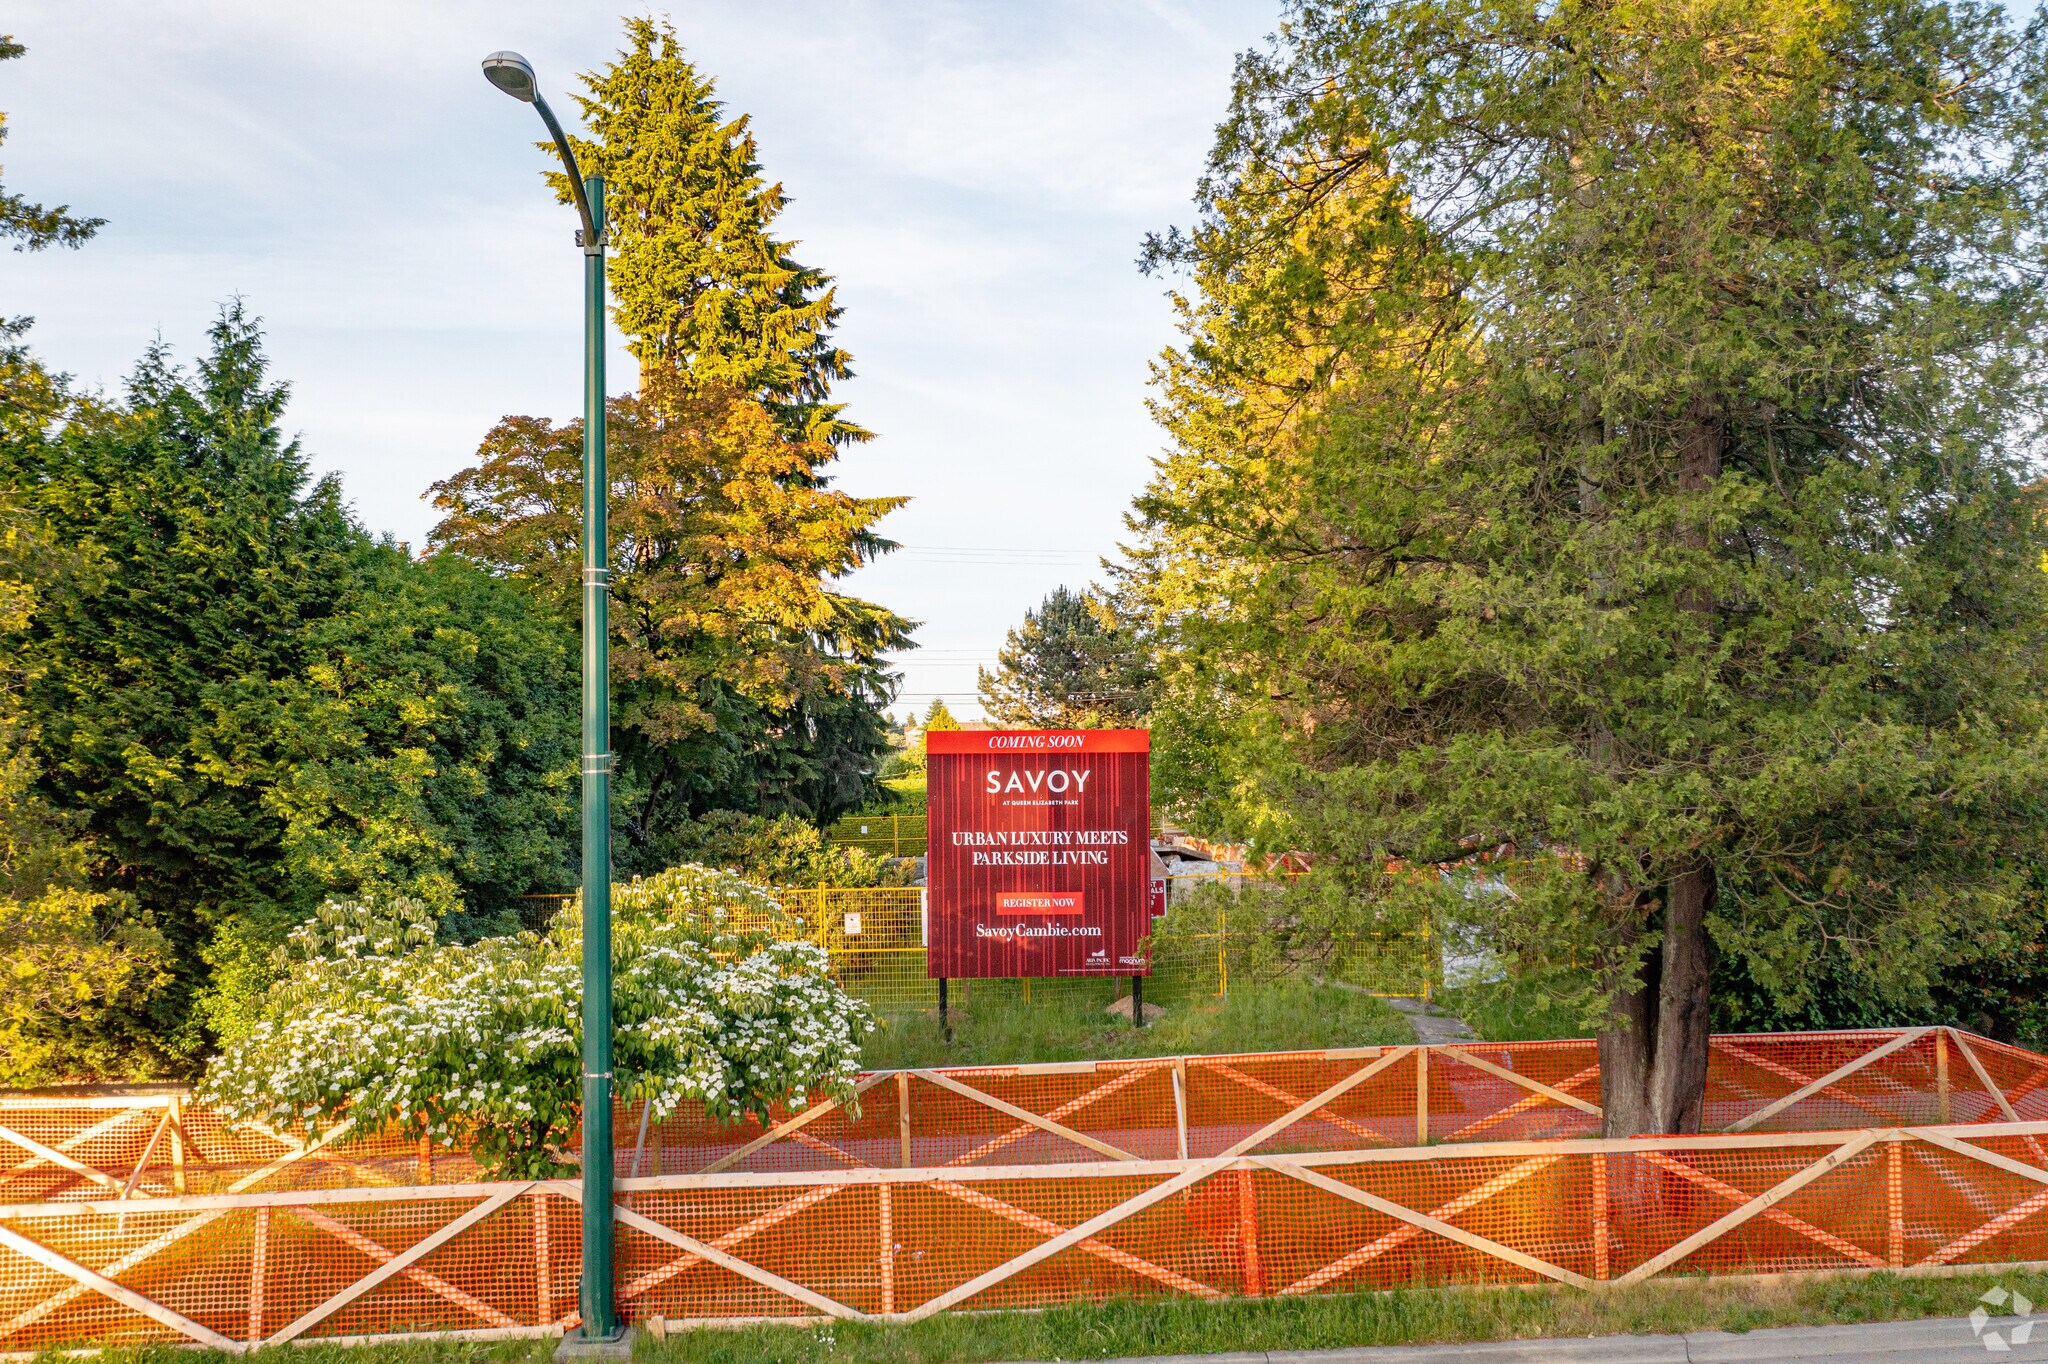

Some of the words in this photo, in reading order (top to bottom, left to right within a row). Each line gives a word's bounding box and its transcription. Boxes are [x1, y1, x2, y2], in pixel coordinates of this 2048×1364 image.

[988, 735, 1046, 749] COMING
[1047, 735, 1086, 748] SOON
[986, 769, 1091, 794] SAVOY
[952, 831, 1009, 846] URBAN
[1010, 831, 1074, 846] LUXURY
[1075, 830, 1129, 845] MEETS
[972, 851, 1050, 866] PARKSIDE
[1051, 850, 1109, 865] LIVING
[1003, 898, 1051, 908] REGISTER
[1052, 897, 1076, 907] NOW
[976, 922, 1102, 942] SavoyCambie.com
